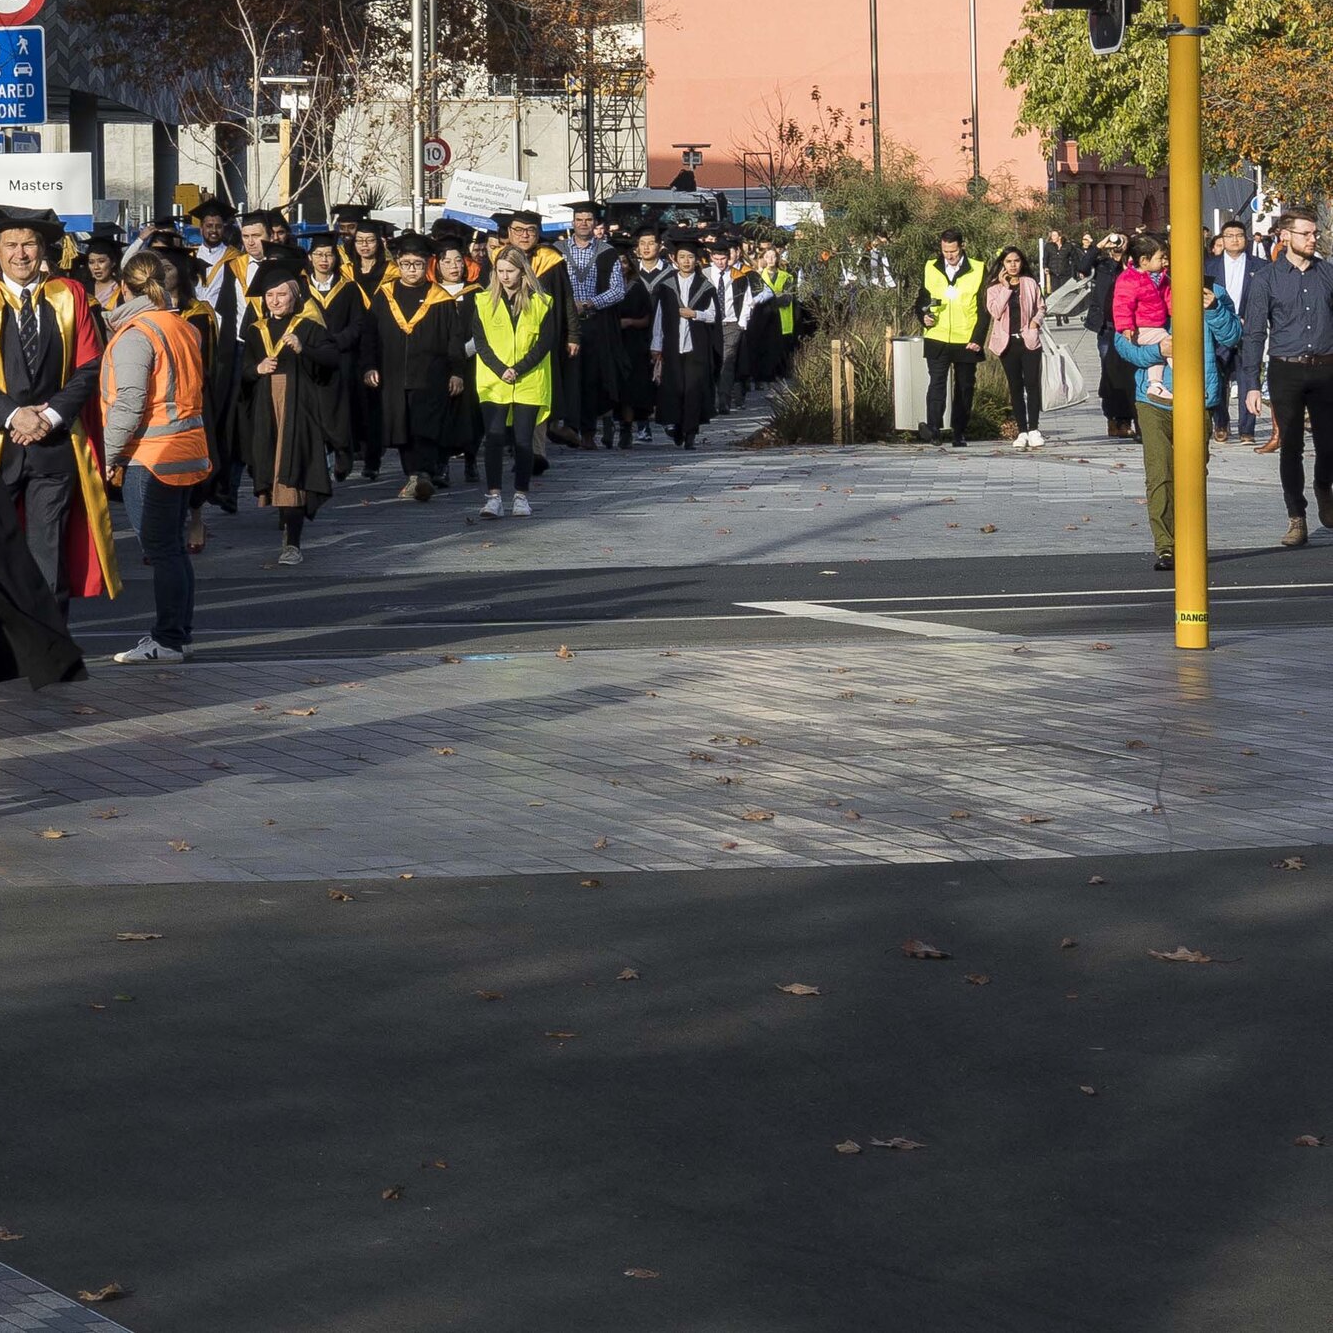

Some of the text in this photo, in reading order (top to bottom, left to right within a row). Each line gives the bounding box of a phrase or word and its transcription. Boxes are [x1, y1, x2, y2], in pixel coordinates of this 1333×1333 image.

[426, 147, 442, 161] 10
[9, 179, 64, 191] Masters
[456, 176, 523, 194] Postgraduate Diplomas
[471, 186, 505, 198] Certificates
[457, 192, 512, 208] Graduate Diplomas
[469, 201, 501, 212] Certificate
[1180, 613, 1209, 623] DANGE
